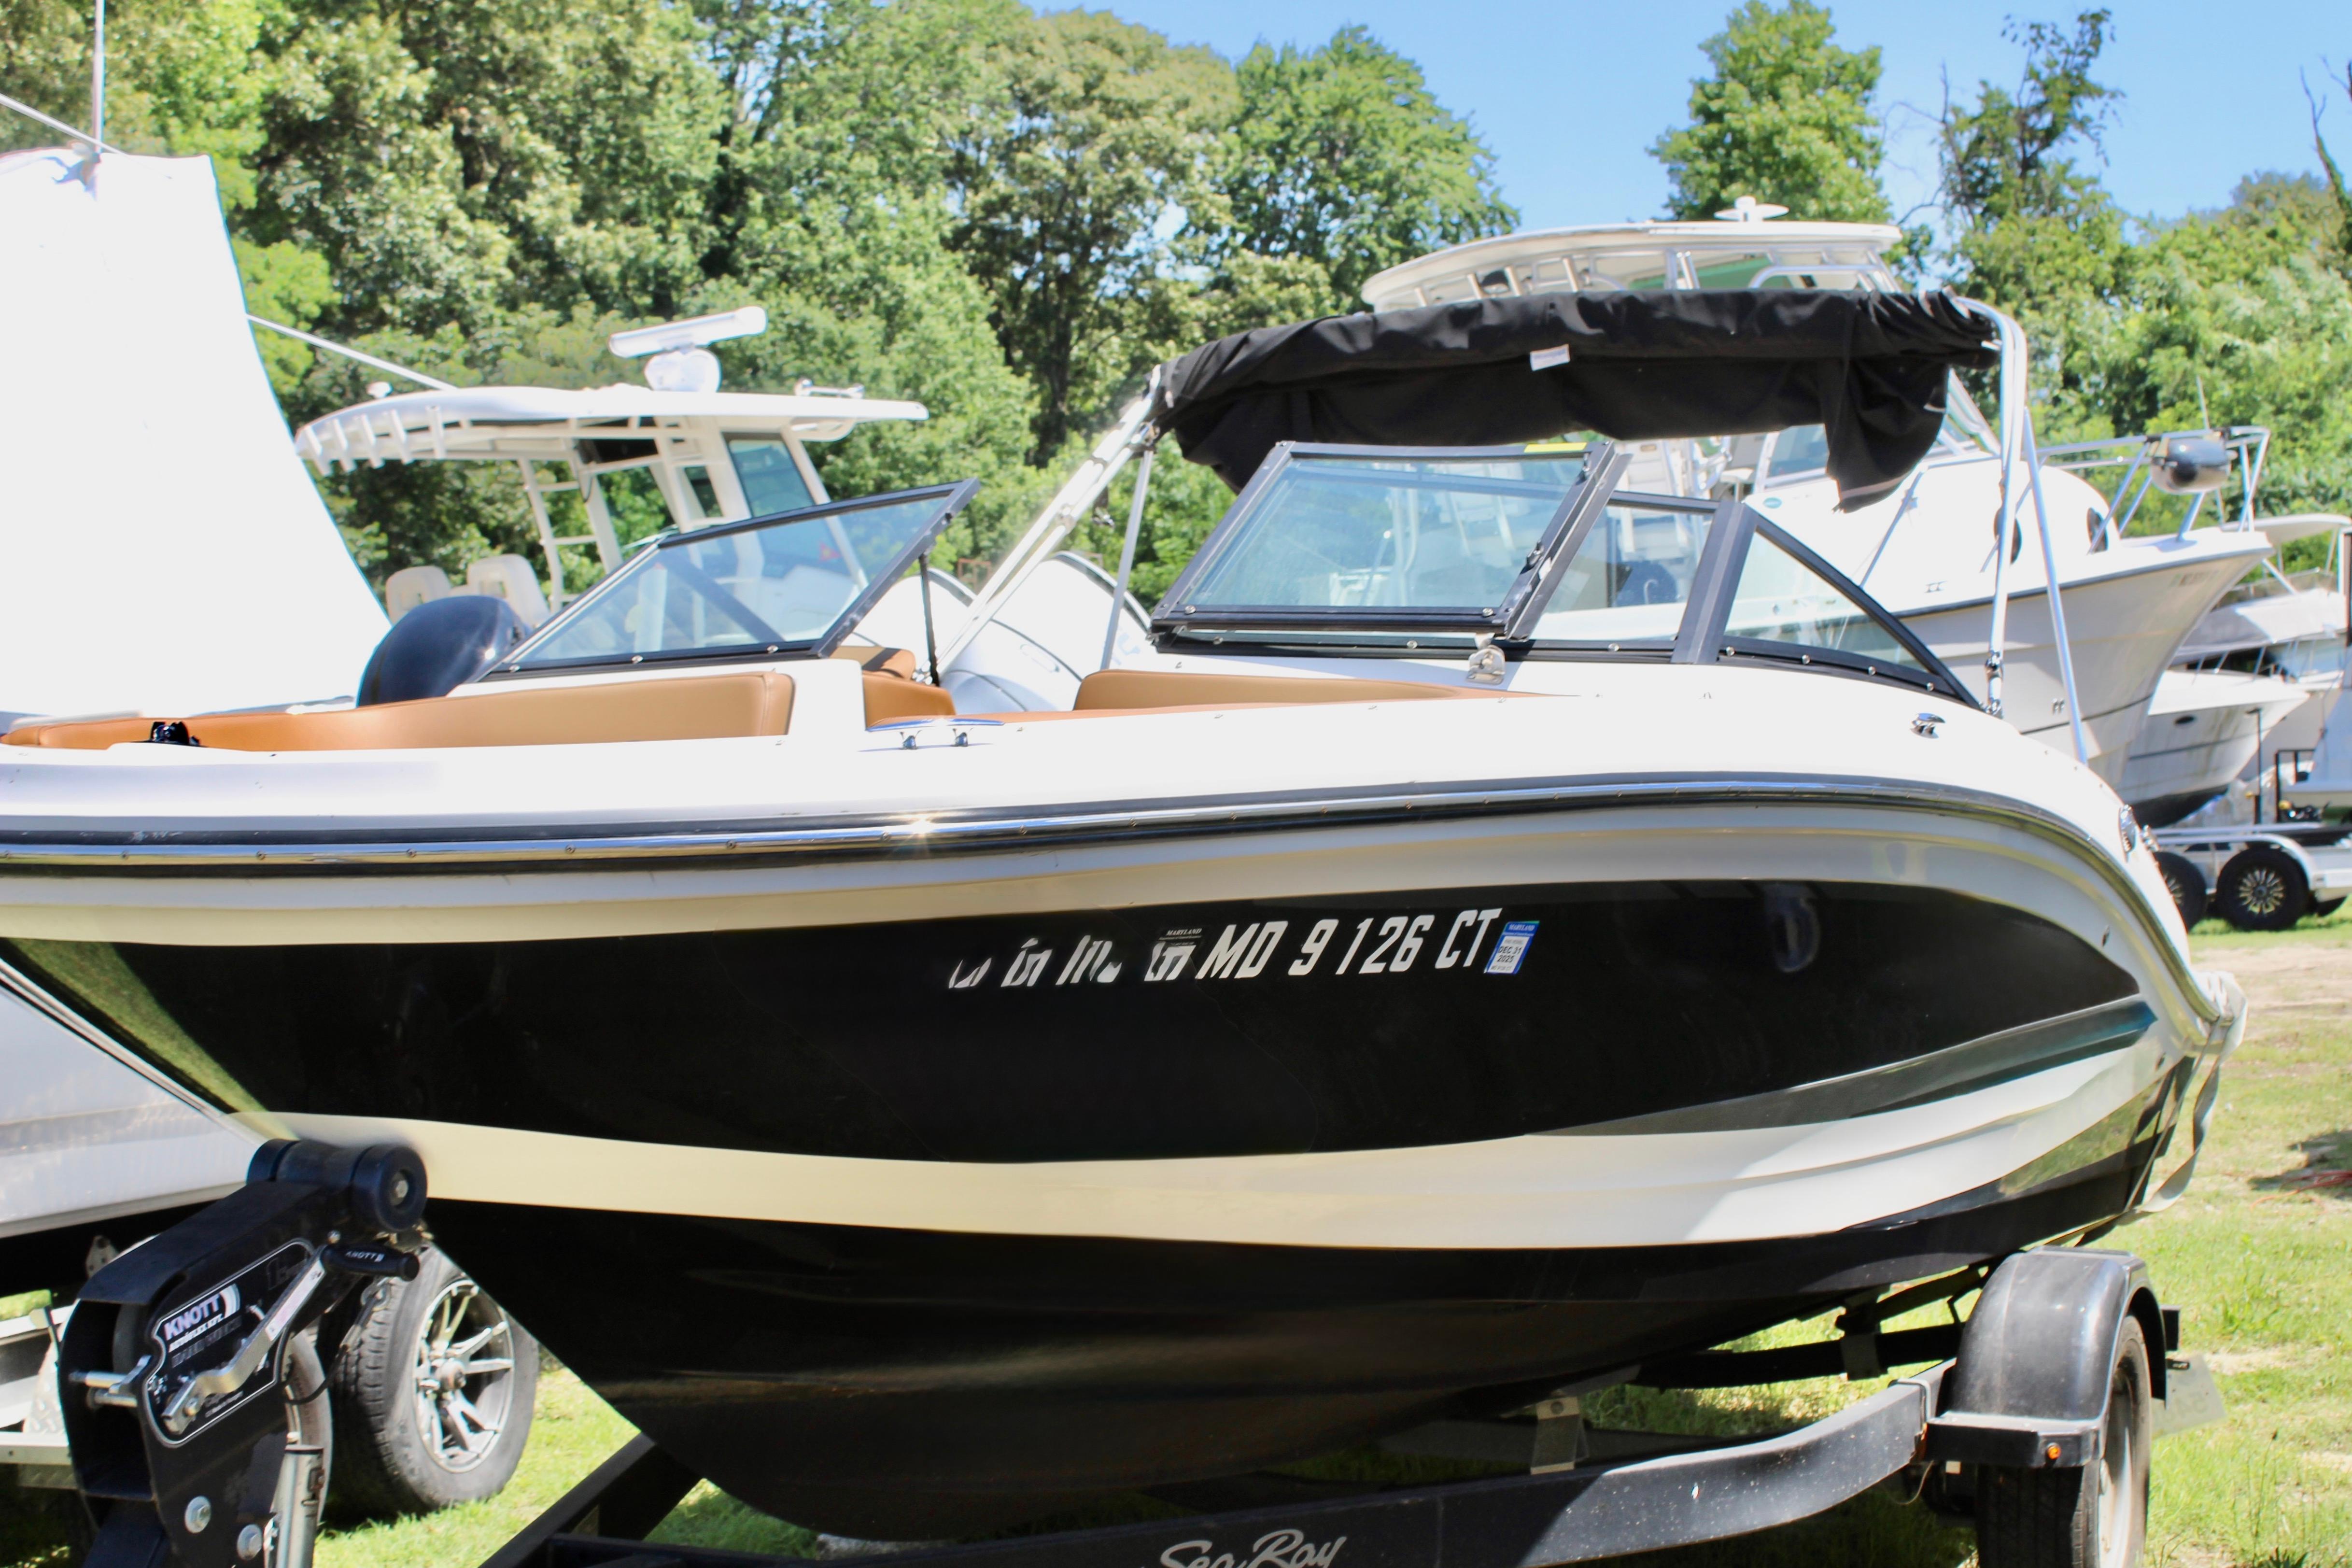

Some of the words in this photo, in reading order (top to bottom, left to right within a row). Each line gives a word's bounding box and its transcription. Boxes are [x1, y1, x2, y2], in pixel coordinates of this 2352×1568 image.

[1195, 921, 1288, 979] MD
[1435, 908, 1503, 969] CT
[164, 1293, 220, 1341] KNOTT
[1252, 1529, 1347, 1568] Ray
